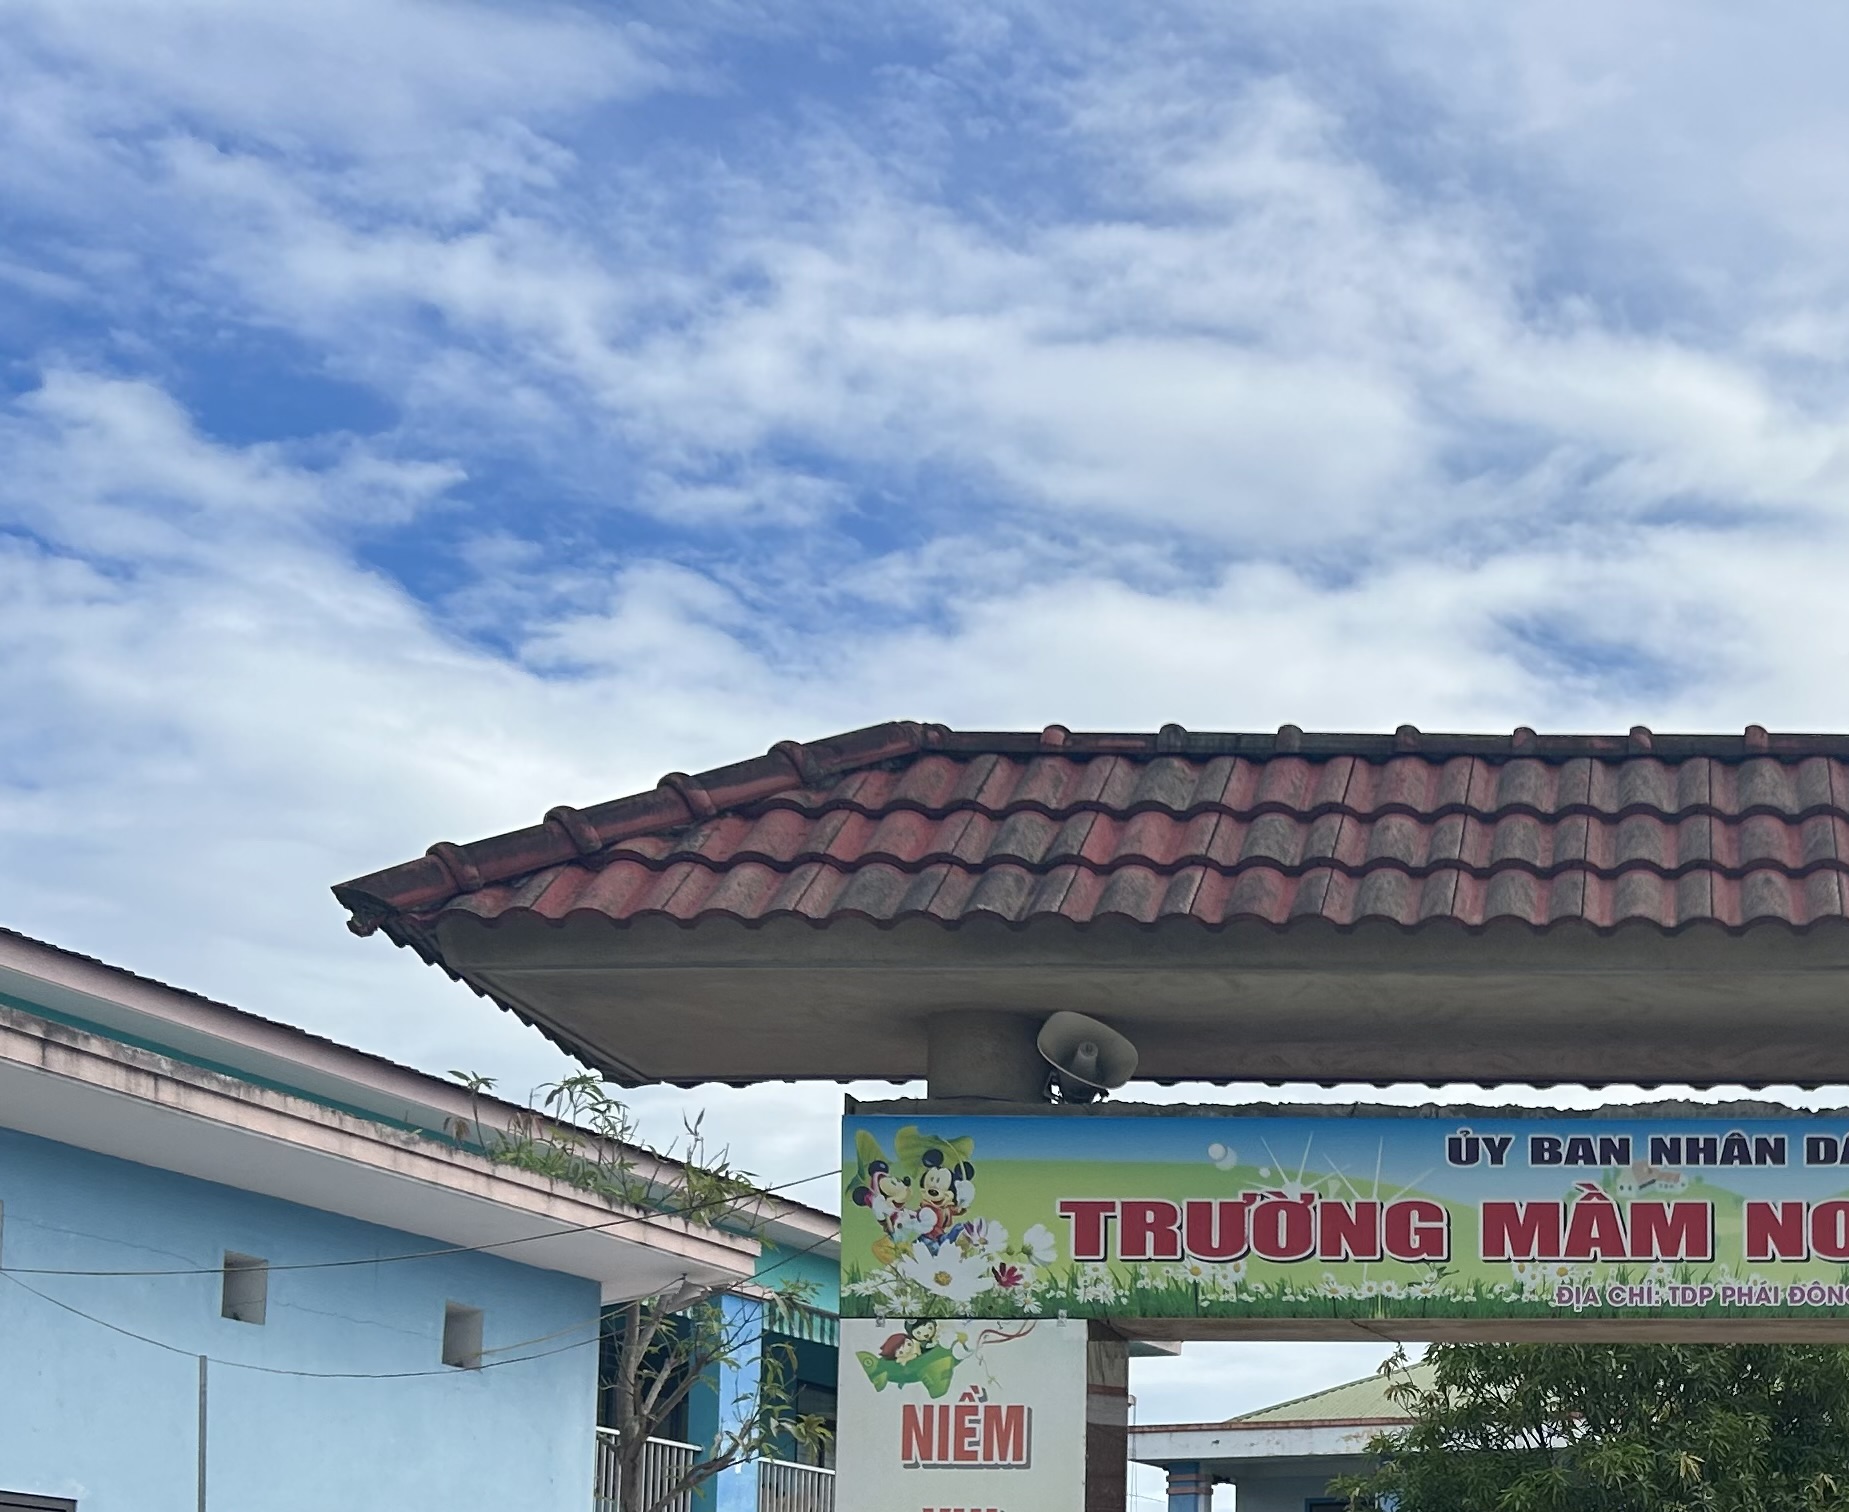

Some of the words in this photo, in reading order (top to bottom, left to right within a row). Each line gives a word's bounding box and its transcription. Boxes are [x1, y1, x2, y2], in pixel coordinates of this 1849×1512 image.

[1448, 1129, 1514, 1166] ỦY
[1530, 1136, 1632, 1166] BAN
[1650, 1131, 1787, 1166] NHÂN
[1060, 1193, 1444, 1259] TRƯỜNG
[1482, 1184, 1710, 1259] MẦM
[1555, 1286, 1601, 1311] ĐỊA
[1669, 1286, 1713, 1305] TDP
[903, 1384, 1026, 1463] NIỀM
